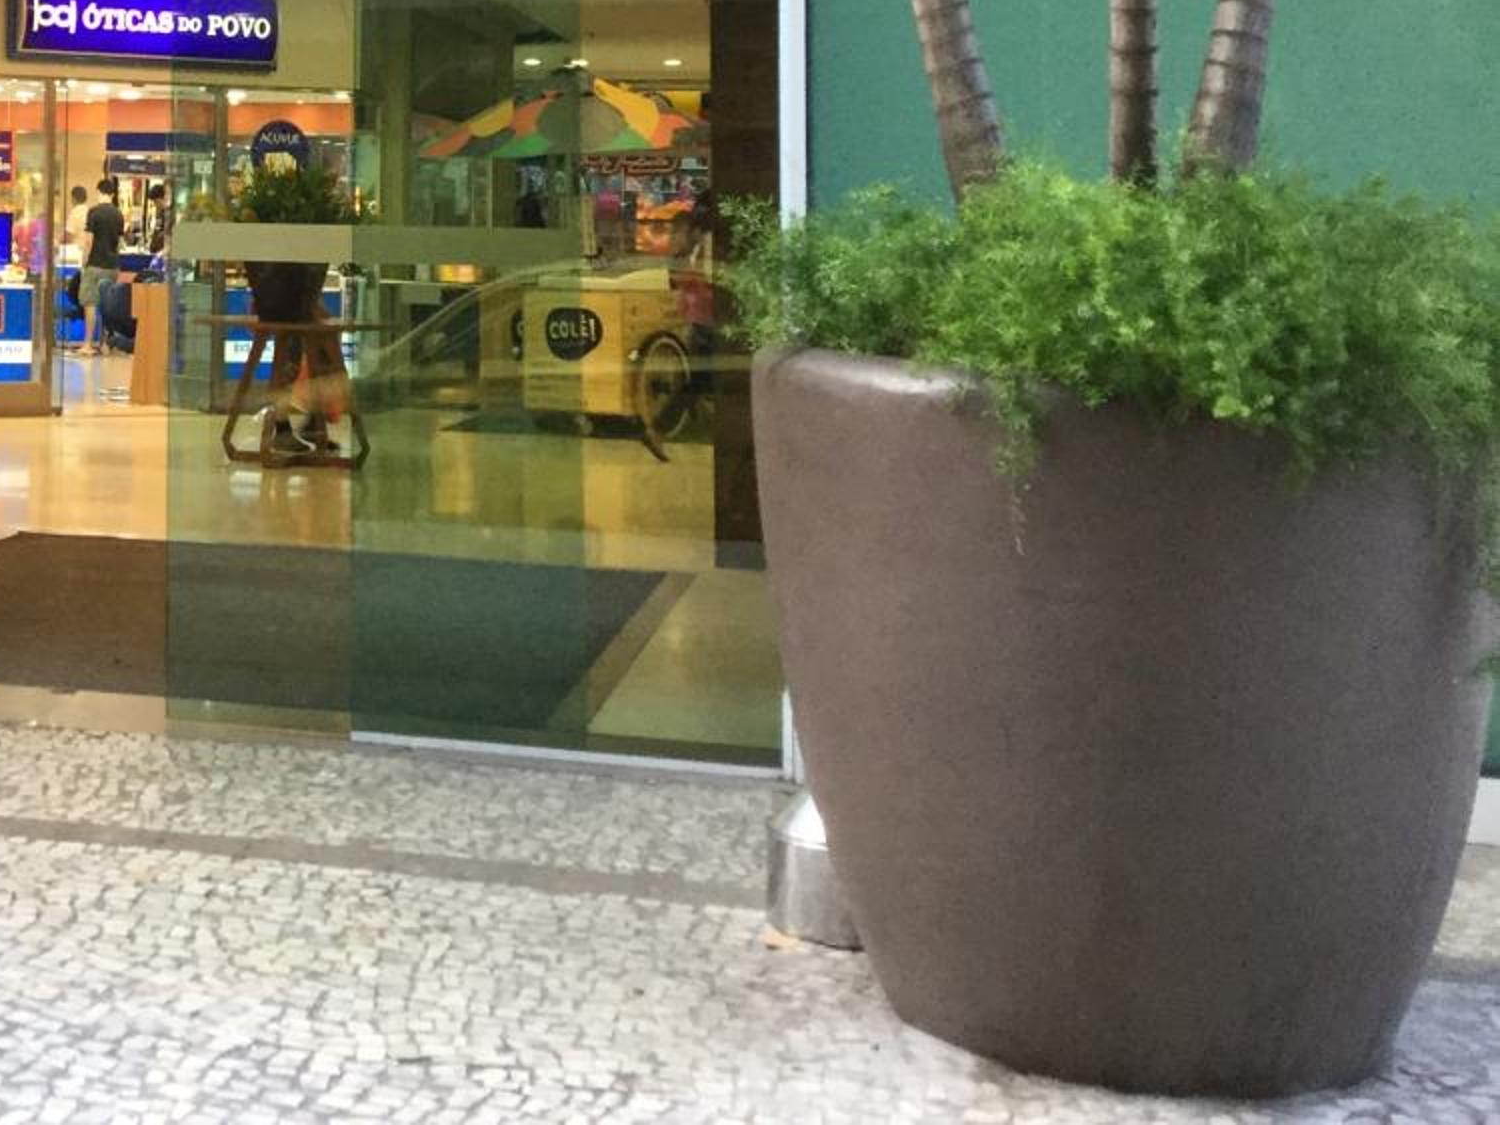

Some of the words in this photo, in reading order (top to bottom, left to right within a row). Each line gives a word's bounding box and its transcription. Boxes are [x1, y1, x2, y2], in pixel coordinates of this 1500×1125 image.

[82, 2, 175, 34] ÓTICAS
[177, 15, 203, 34] DO
[206, 13, 271, 40] POVO
